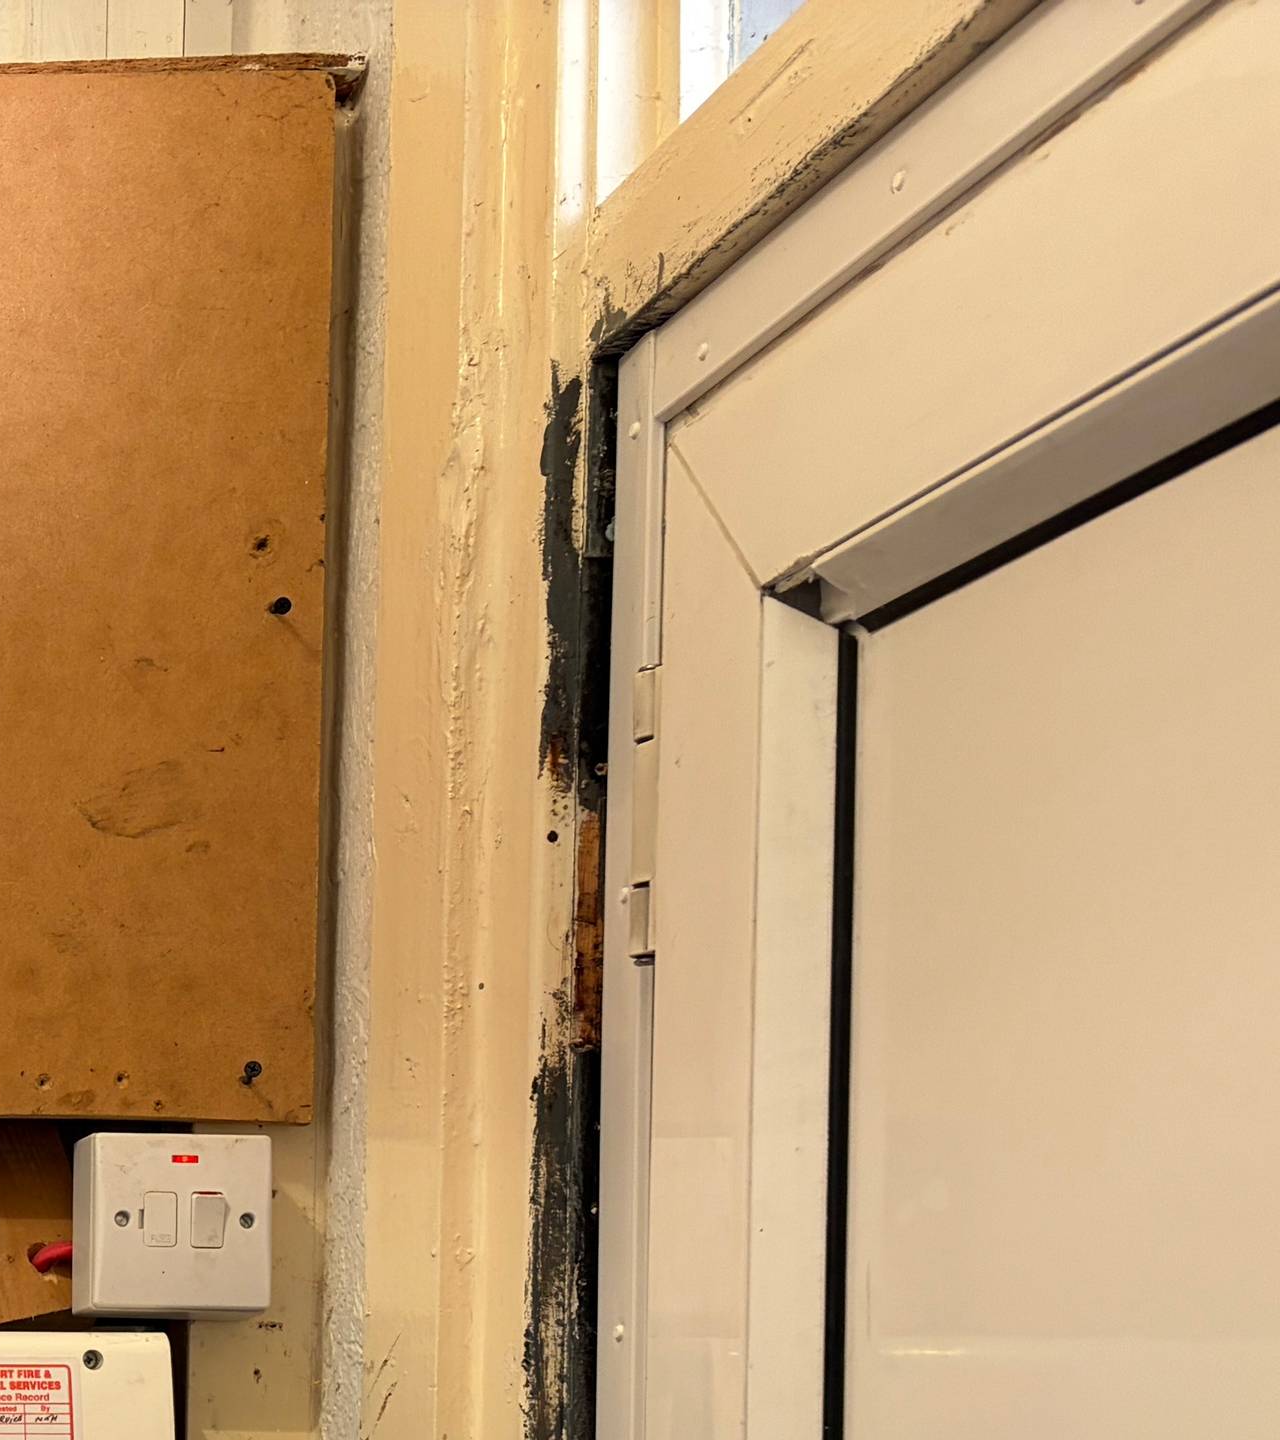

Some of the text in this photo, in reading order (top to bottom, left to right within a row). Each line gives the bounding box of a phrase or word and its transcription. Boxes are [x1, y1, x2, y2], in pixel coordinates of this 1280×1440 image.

[17, 1370, 42, 1379] FIRE
[44, 1370, 52, 1379] &
[9, 1381, 62, 1390] SERVICES
[15, 1392, 50, 1401] Record
